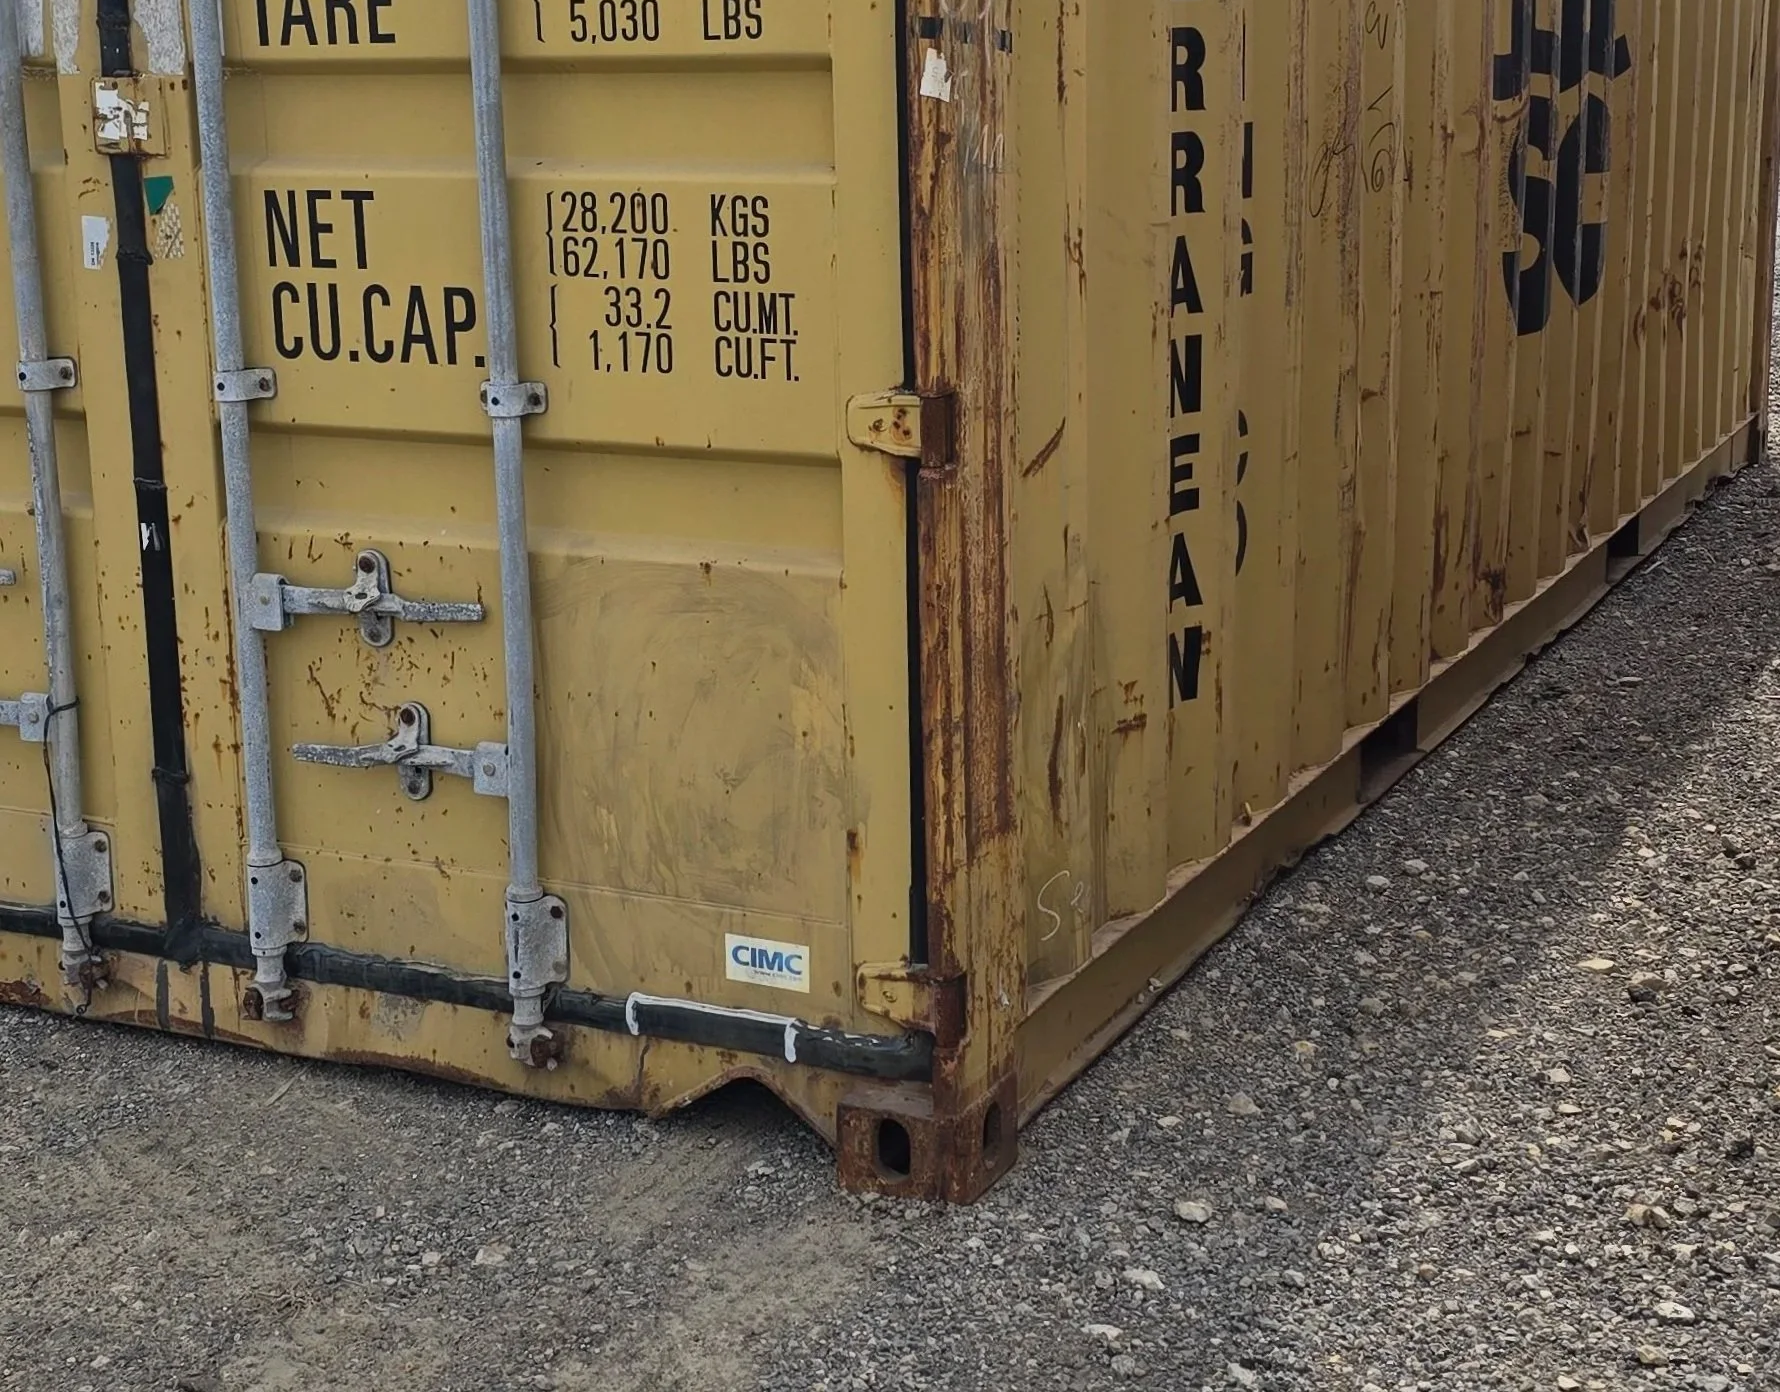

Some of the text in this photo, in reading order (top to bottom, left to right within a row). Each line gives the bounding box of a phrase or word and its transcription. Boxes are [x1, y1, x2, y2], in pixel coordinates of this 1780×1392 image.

[263, 189, 375, 270] NET
[560, 190, 770, 238] 28,200 KGS
[562, 235, 771, 284] 62,170 LBS
[271, 281, 486, 368] CU.CAP.
[604, 285, 799, 337] 33.2 CU.MT.
[588, 330, 801, 382] 1,170 CU.FT.
[731, 945, 803, 976] CIMC
